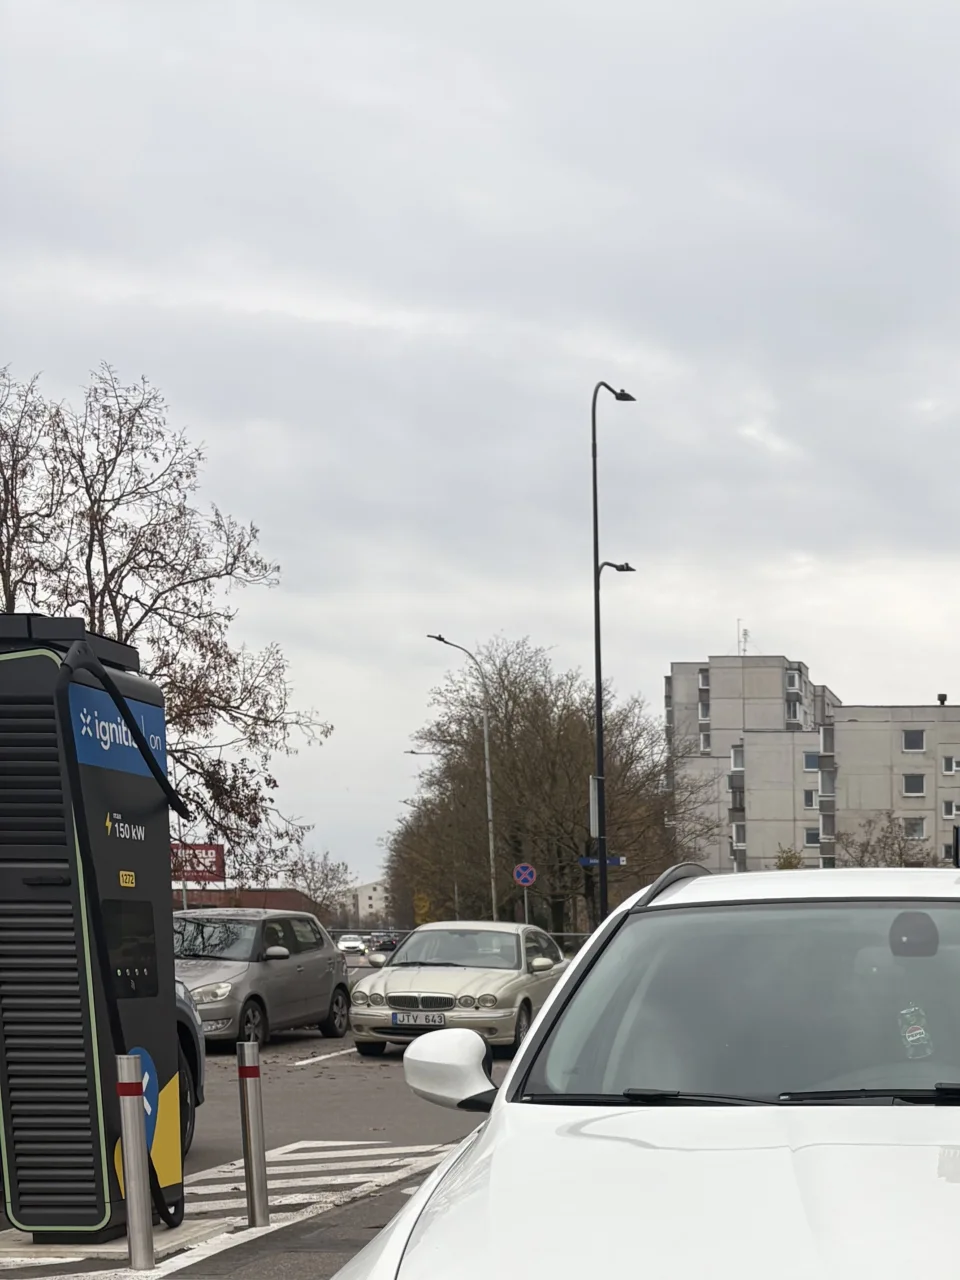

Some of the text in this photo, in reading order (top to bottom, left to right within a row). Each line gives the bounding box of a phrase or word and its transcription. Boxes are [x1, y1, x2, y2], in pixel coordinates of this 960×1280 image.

[94, 711, 162, 751] igniti on
[114, 822, 145, 841] 150 kW
[121, 874, 135, 884] 1272
[399, 1014, 443, 1024] JTV 643
